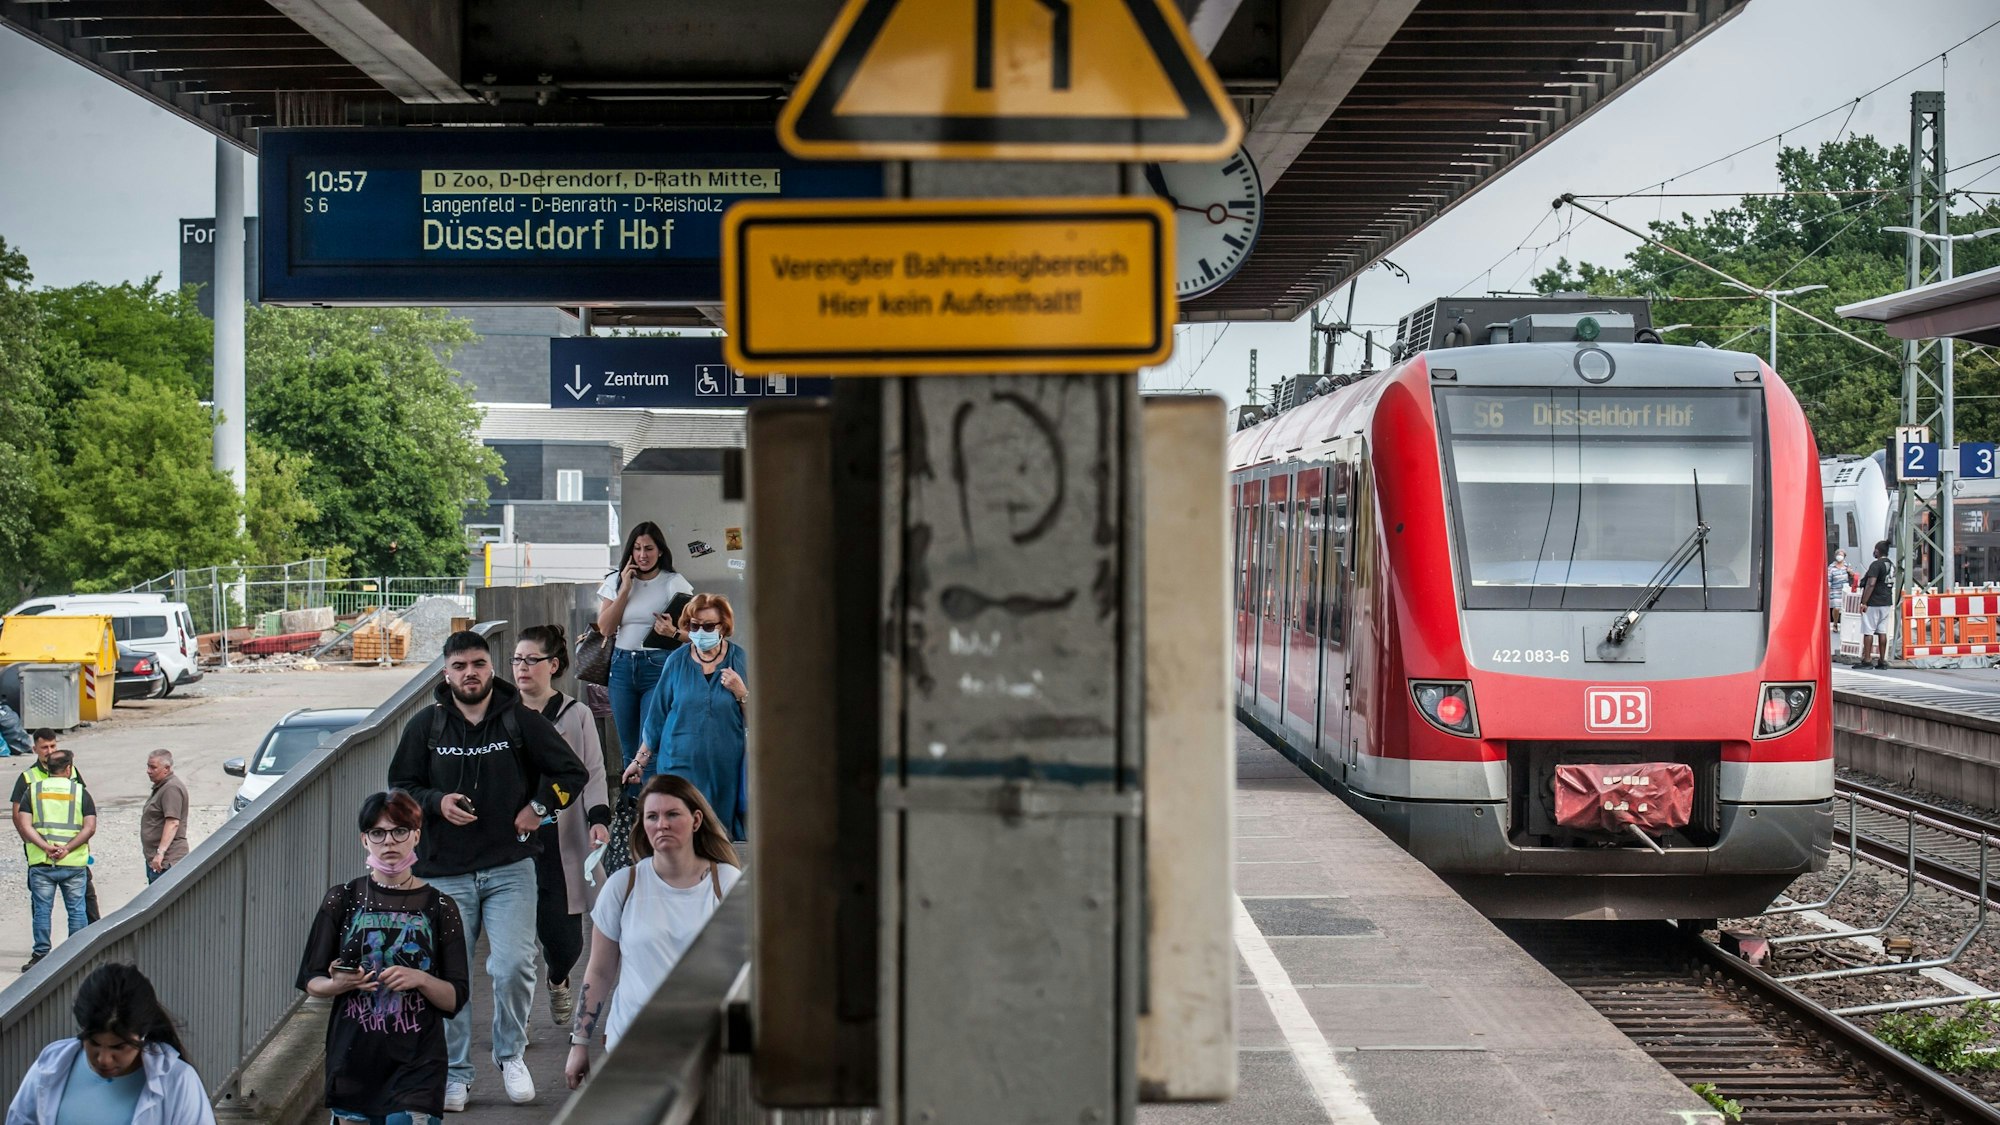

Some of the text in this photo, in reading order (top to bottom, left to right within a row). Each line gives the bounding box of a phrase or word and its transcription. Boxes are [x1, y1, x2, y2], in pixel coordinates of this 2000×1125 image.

[305, 171, 368, 193] 10:57
[434, 172, 446, 188] D
[453, 172, 493, 190] Zoo,
[500, 172, 628, 190] D-Derendorf,
[635, 172, 702, 188] D-Rath
[708, 172, 768, 189] Mitte,
[304, 197, 329, 213] S 6
[423, 197, 516, 217] Langenfeld
[532, 197, 617, 213] D-Benrath
[635, 196, 723, 213] D-Reisholz
[423, 218, 675, 250] Düsseldorf Hbf
[770, 250, 1130, 285] Verengter Bahnsteigbereich
[818, 288, 1083, 318] Hier kein Aufenthalt!
[604, 371, 669, 387] Zentrum
[1473, 401, 1694, 429] S6 Düsseldorf Hbf
[1908, 446, 1924, 470] 2
[1975, 449, 1993, 474] 3
[1492, 649, 1570, 663] 422 083-6
[1594, 694, 1643, 725] DB
[358, 1009, 422, 1034] FOR ALL
